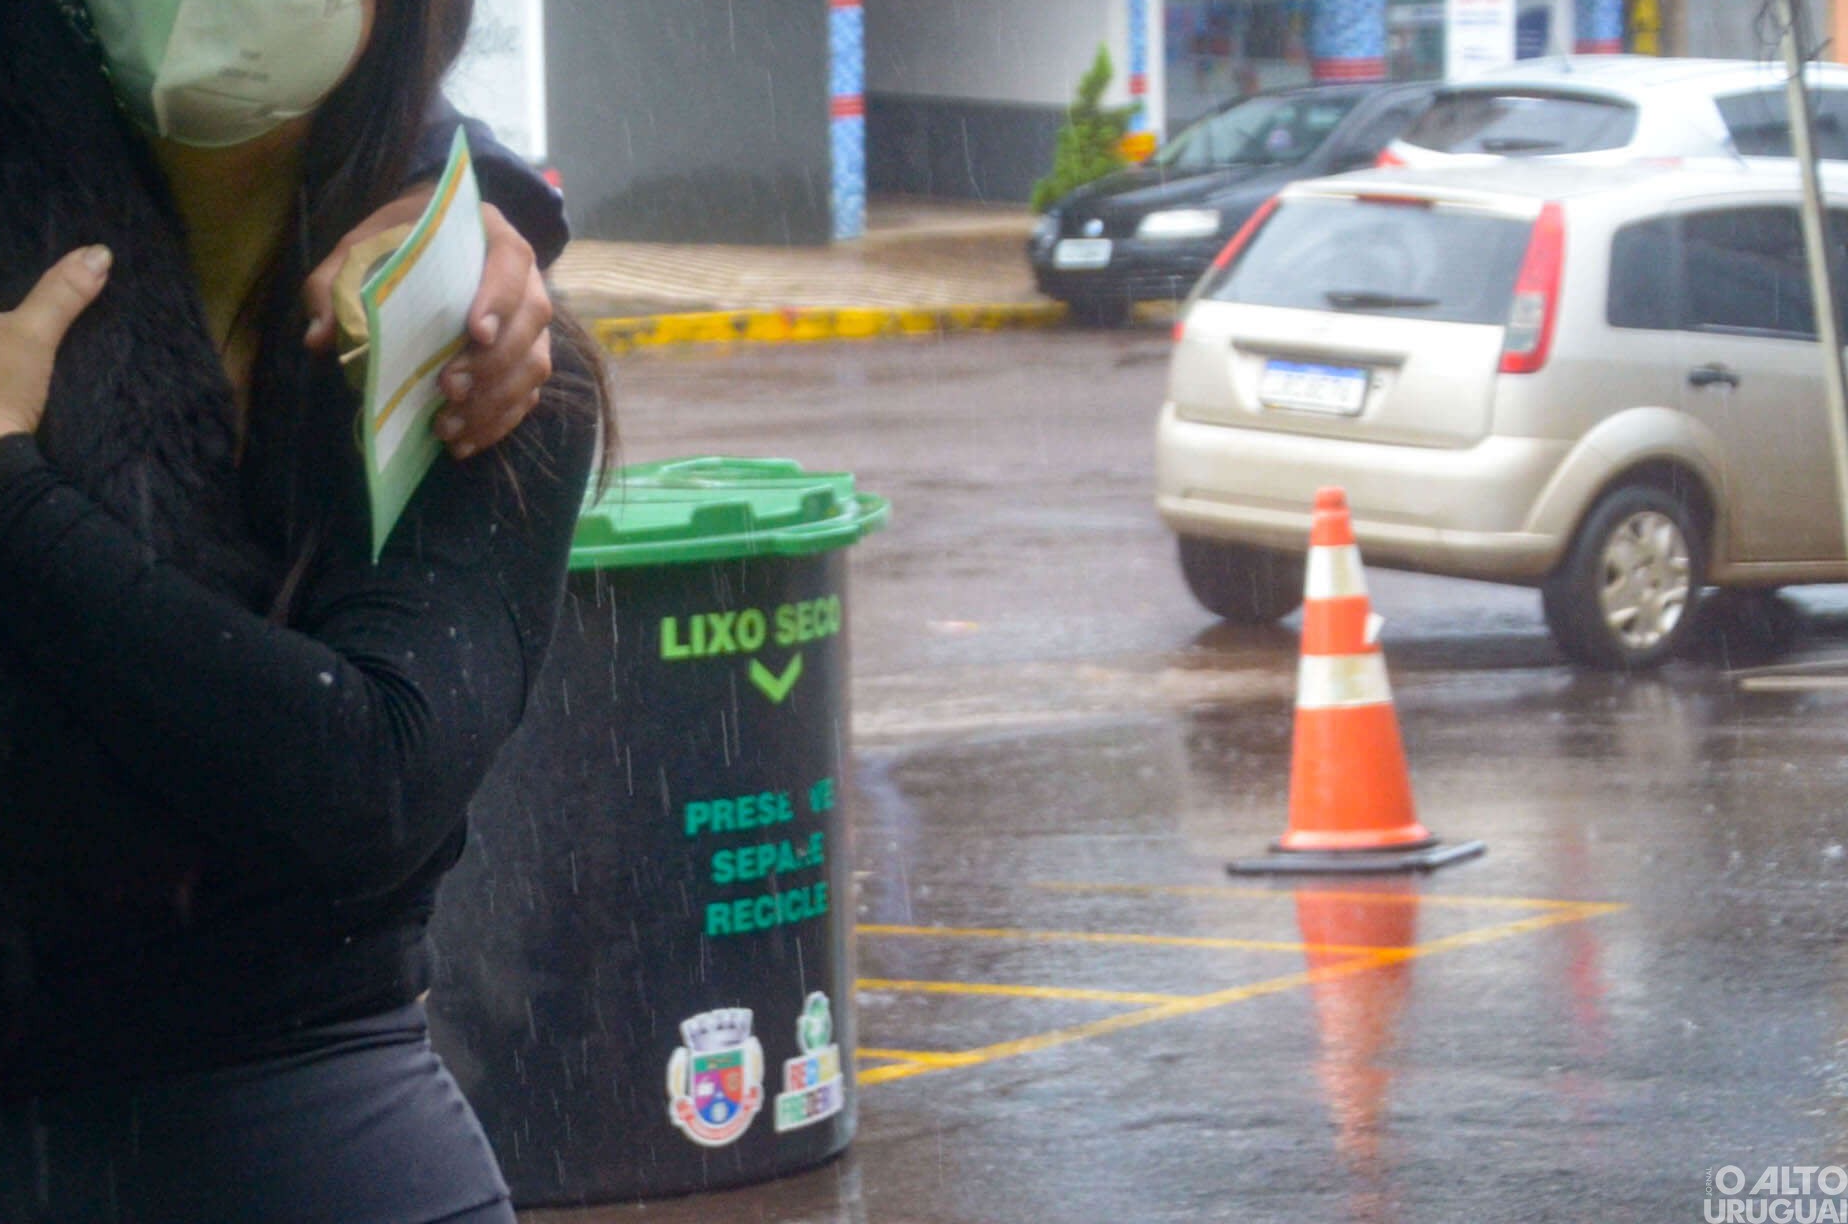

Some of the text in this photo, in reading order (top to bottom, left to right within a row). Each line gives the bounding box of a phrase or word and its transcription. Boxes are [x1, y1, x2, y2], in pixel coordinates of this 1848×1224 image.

[660, 608, 767, 660] LIXO
[712, 831, 825, 885] SEPAE
[706, 880, 830, 937] RECICLE
